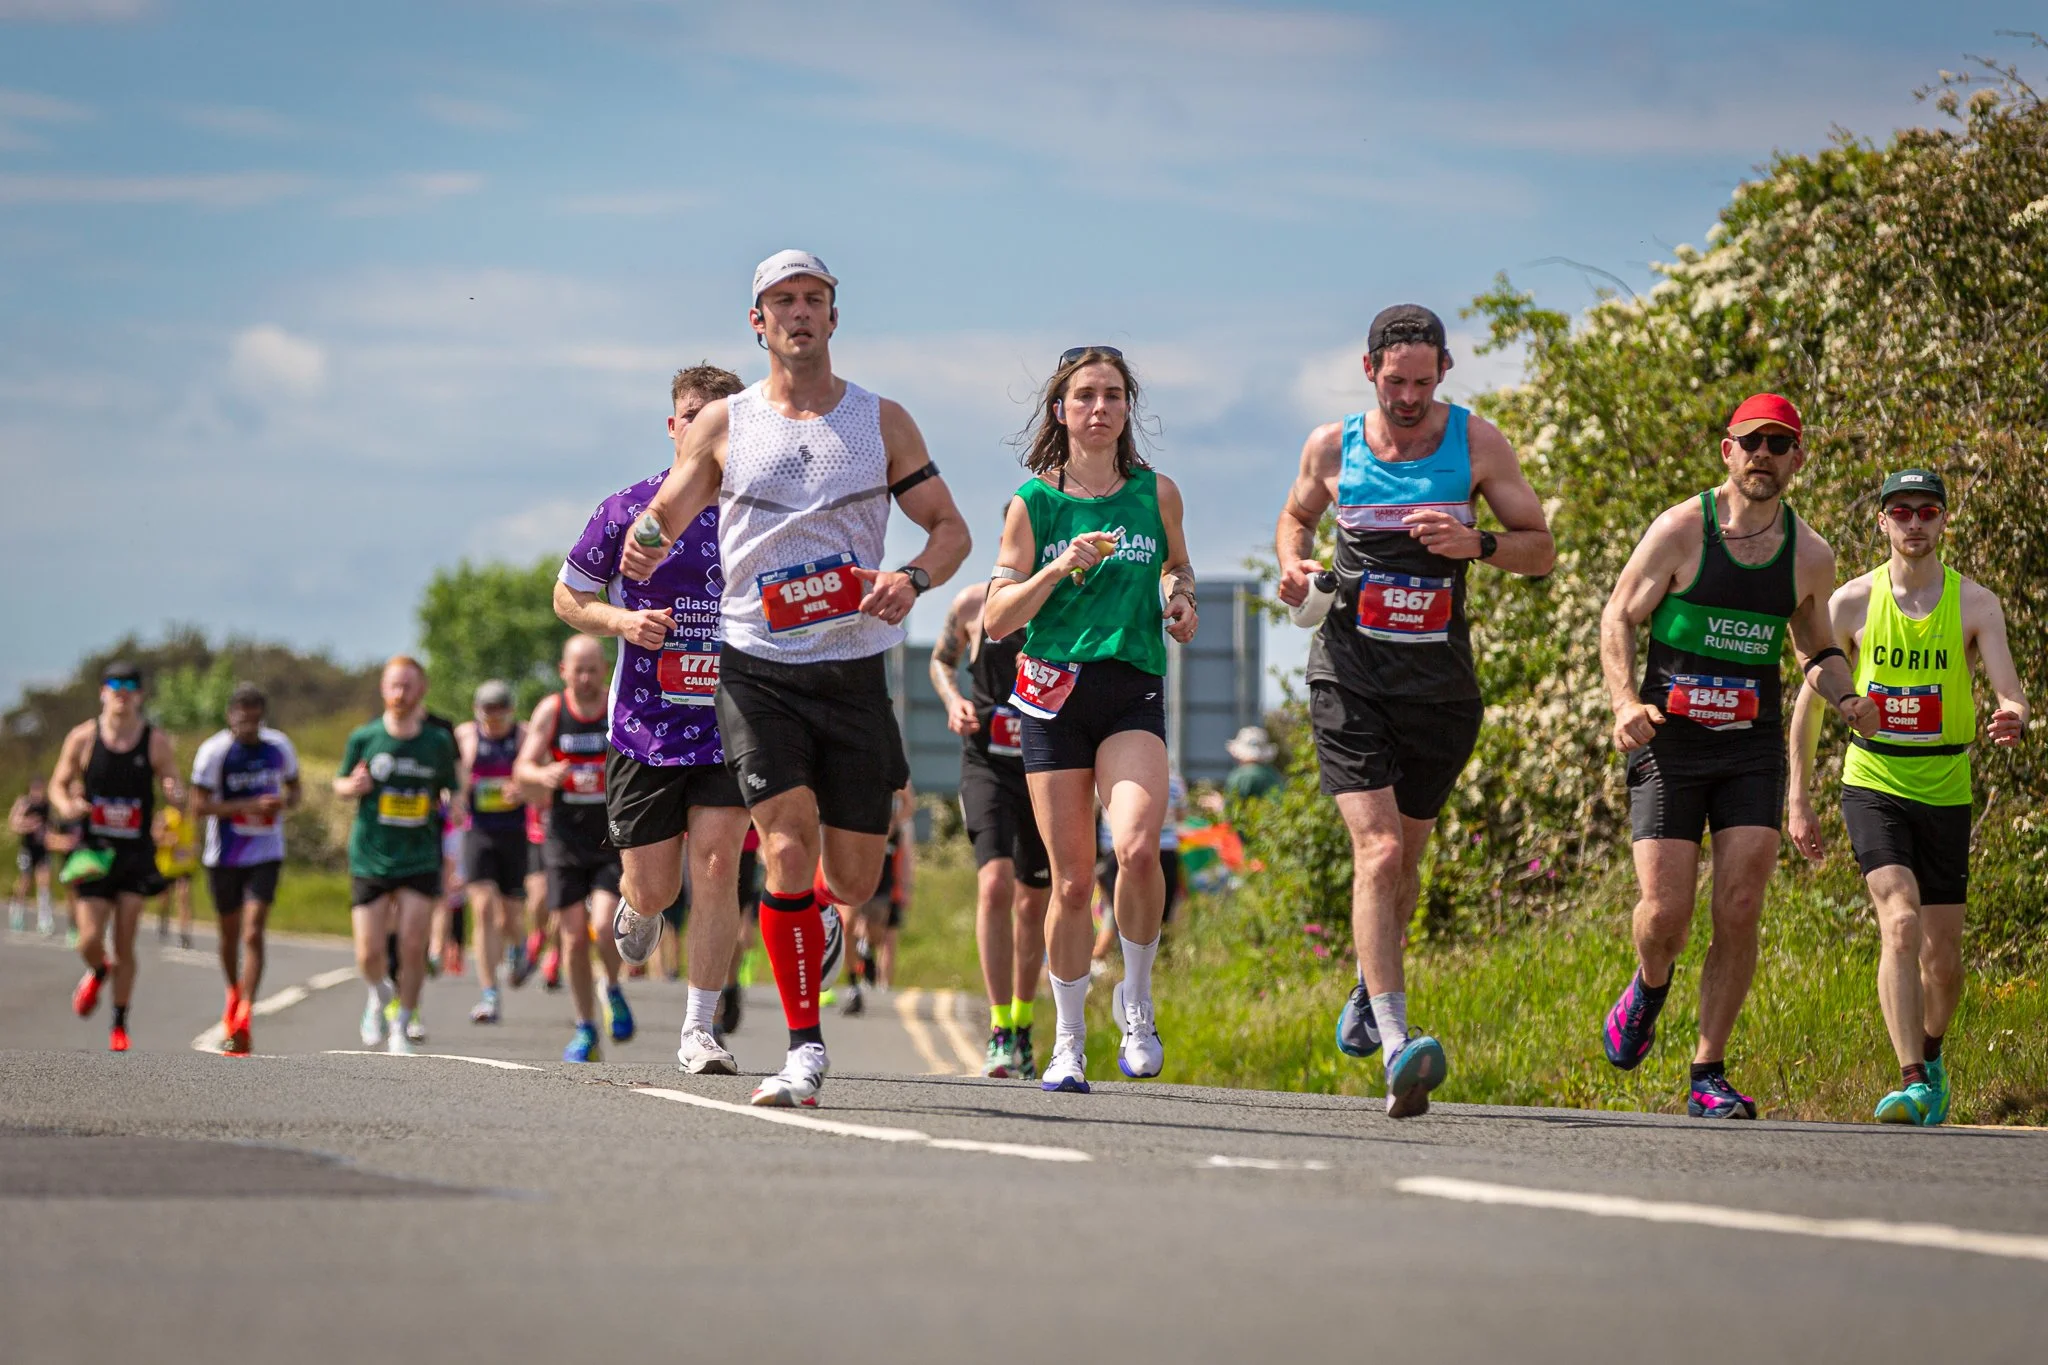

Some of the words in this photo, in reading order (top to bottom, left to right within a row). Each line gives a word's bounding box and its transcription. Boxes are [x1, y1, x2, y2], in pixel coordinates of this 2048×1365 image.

[1042, 534, 1156, 562] MALAN
[779, 571, 842, 604] 1308
[675, 597, 720, 614] Glasg
[803, 600, 830, 614] NEIL
[1381, 588, 1436, 610] 1367
[1389, 612, 1424, 623] ADAM
[1708, 617, 1775, 641] VEGAN
[1704, 635, 1770, 655] RUNNERS
[1873, 645, 1948, 670] CORIN
[1023, 659, 1061, 688] 1857
[1688, 688, 1739, 708] 1345
[1885, 697, 1921, 714] 815
[1688, 709, 1735, 720] STEPHEN
[1887, 716, 1918, 725] CORIN
